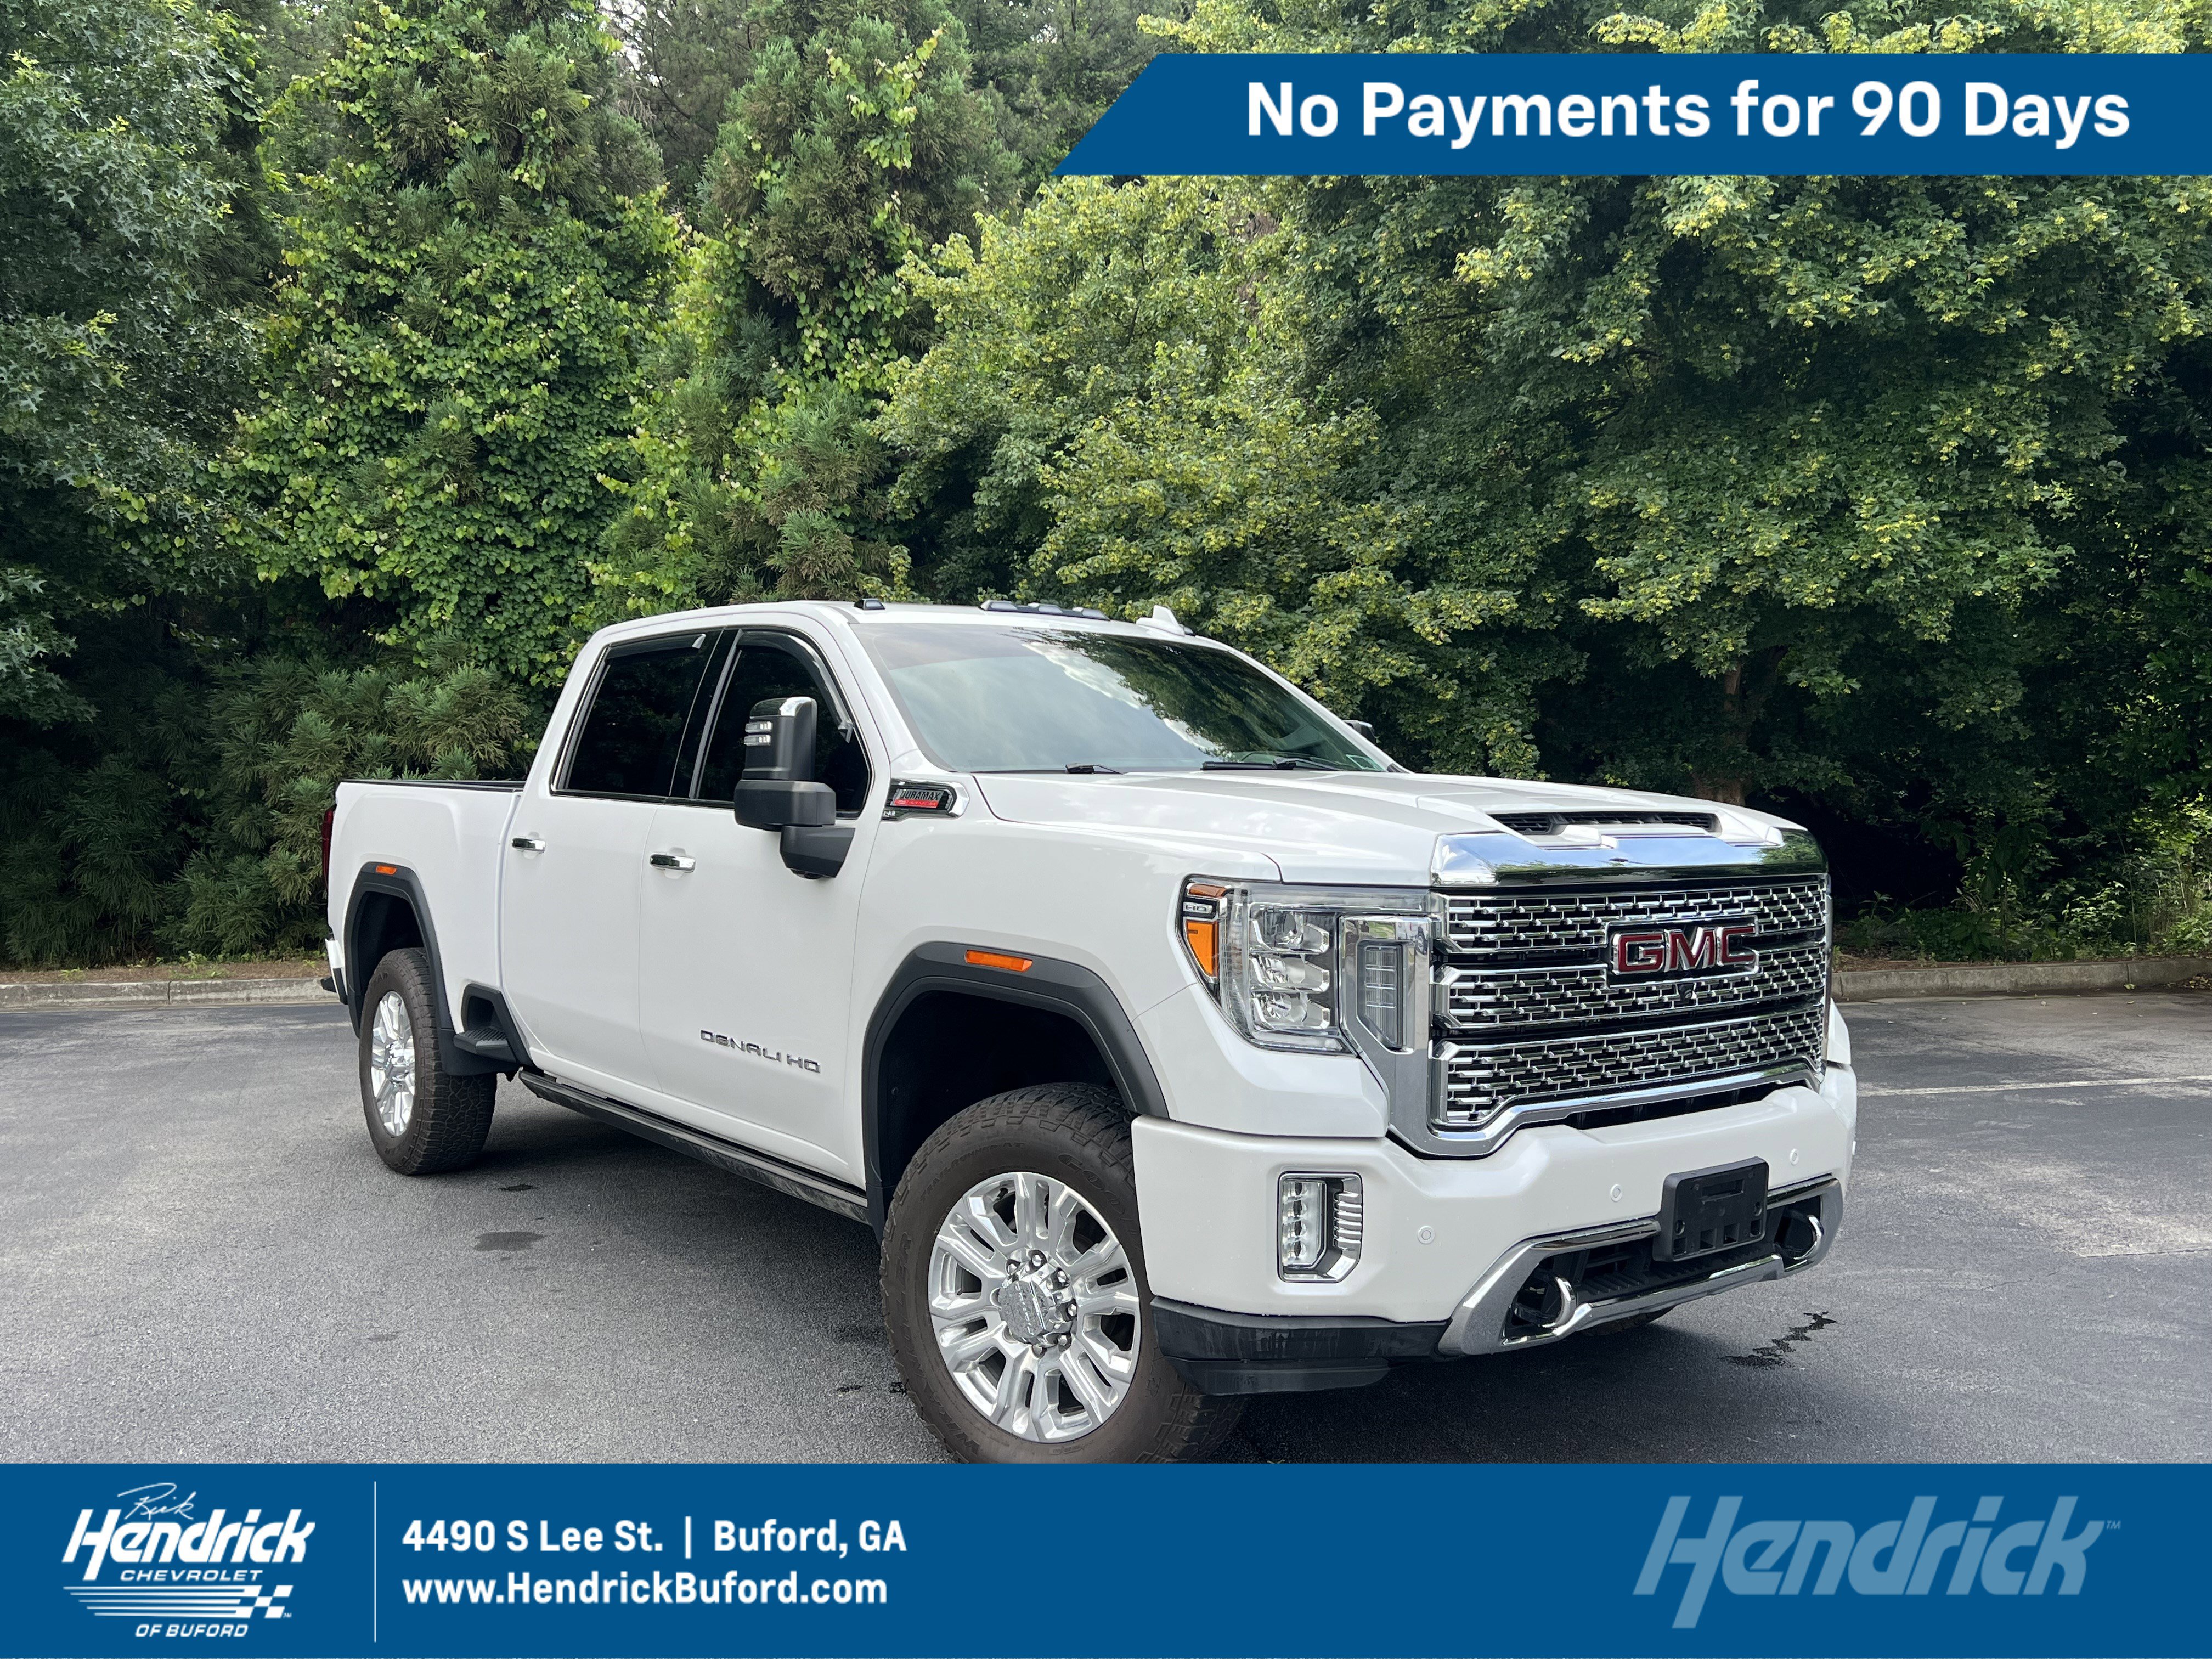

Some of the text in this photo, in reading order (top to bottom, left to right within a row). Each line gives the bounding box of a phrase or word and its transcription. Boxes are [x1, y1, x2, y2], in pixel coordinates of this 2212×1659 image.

[900, 790, 941, 800] DURAMAX
[1613, 926, 1757, 975] GMC
[701, 1029, 821, 1074] DENALI HD
